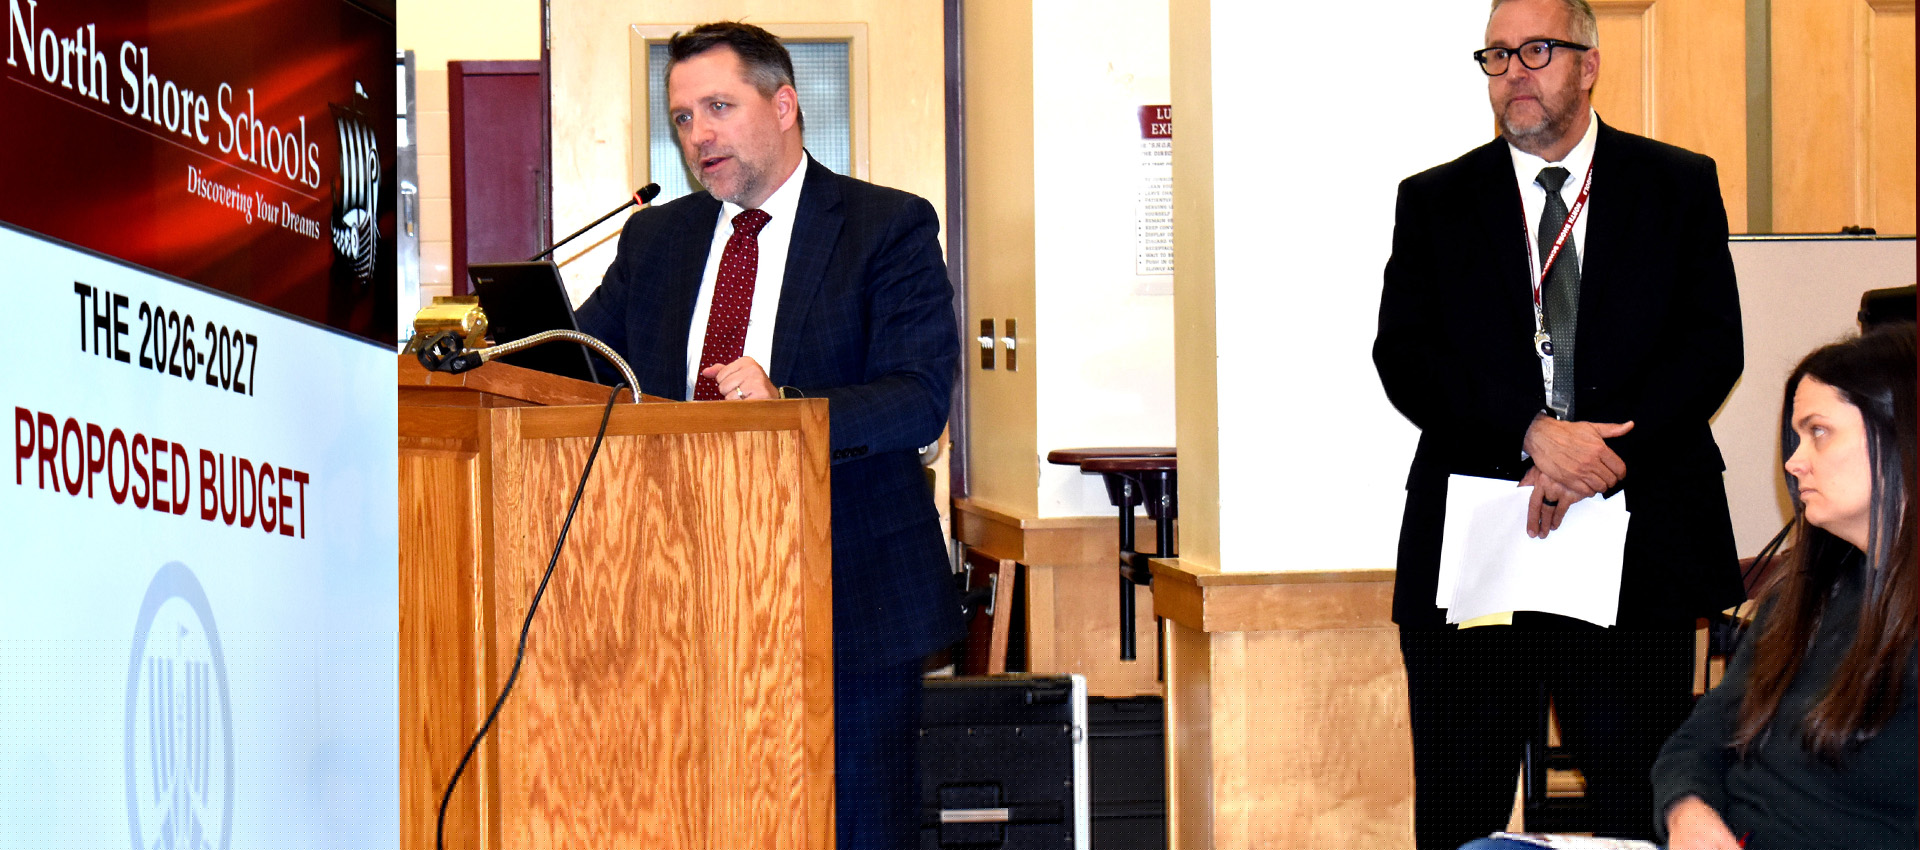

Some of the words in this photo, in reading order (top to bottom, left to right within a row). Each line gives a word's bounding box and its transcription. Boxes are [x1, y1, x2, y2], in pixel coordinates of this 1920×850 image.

[7, 0, 110, 105] North
[119, 40, 210, 145] Shore
[217, 82, 321, 189] Schools
[187, 164, 253, 225] Discovering
[255, 191, 280, 224] Your
[281, 201, 321, 240] Dreams
[1556, 223, 1571, 245] SHORE
[1568, 202, 1582, 224] NORTH
[74, 281, 131, 364] THE
[138, 301, 258, 397] 2026-2027
[14, 406, 191, 516] PROPOSED
[199, 448, 310, 540] BUDGET
